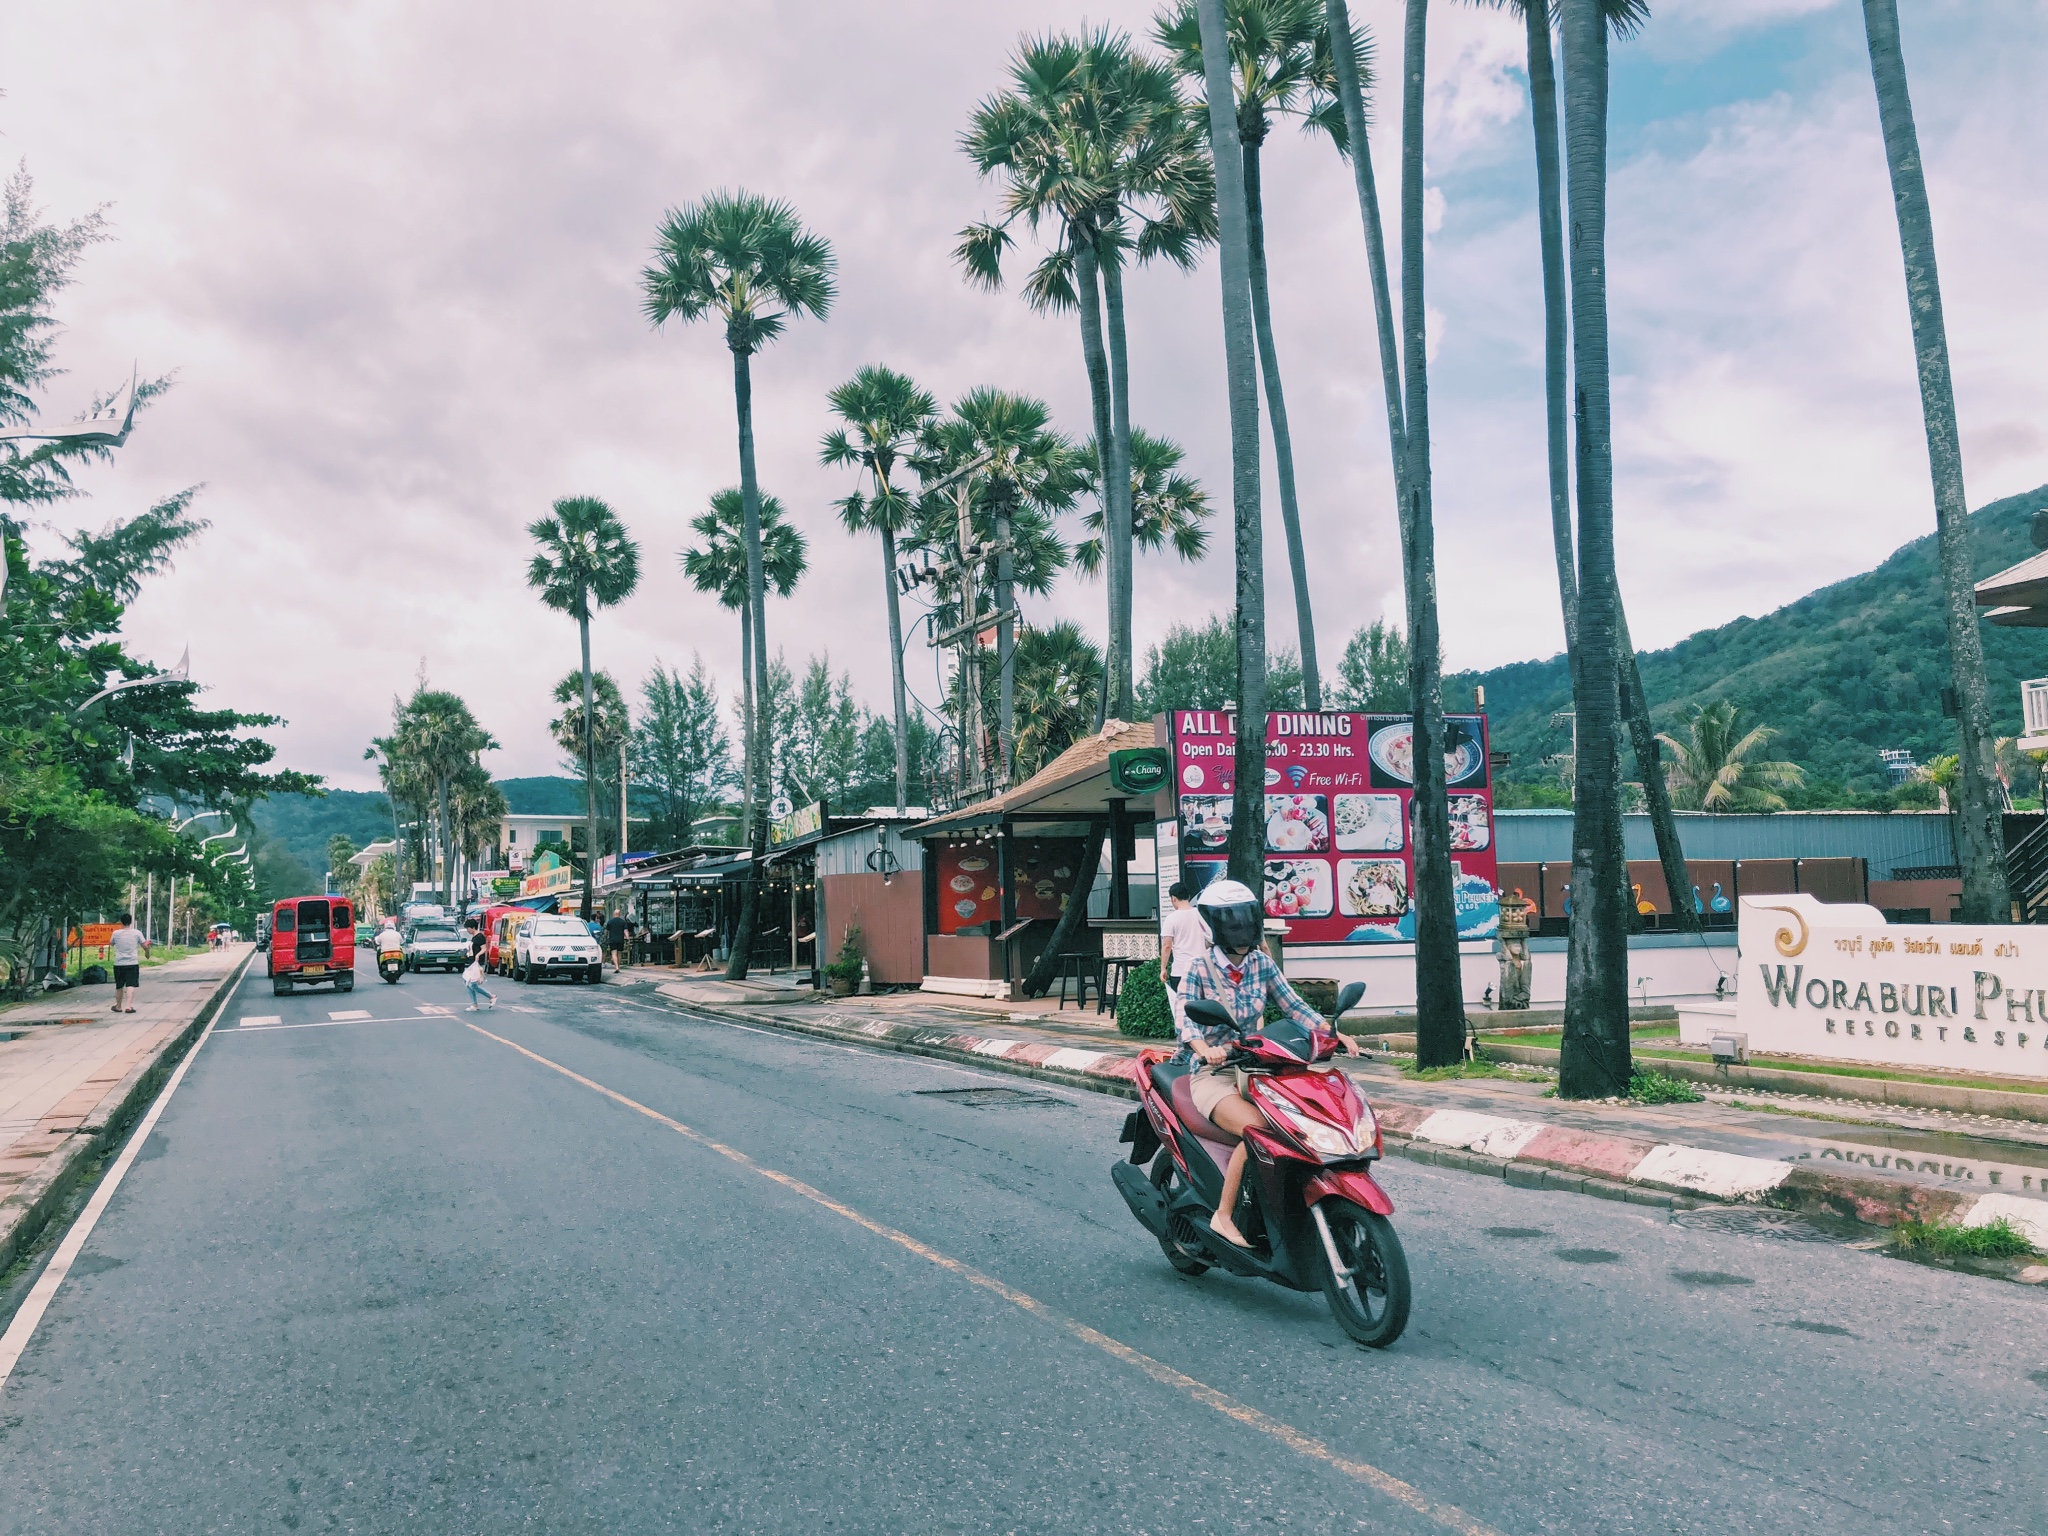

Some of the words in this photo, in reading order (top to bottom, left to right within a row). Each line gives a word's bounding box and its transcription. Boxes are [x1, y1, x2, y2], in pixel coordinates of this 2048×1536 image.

[1181, 713, 1222, 735] ALL
[1277, 714, 1352, 736] DINING
[1182, 742, 1213, 759] Open
[1217, 742, 1236, 756] Dai
[1300, 743, 1330, 757] 23.30
[1333, 743, 1355, 757] Hrs.
[1136, 765, 1162, 775] Chang
[1309, 773, 1331, 786] Free
[1335, 772, 1362, 786] Wi-Fi
[1994, 940, 2019, 957] สปา
[1759, 964, 1958, 1017] WORABURI
[1825, 1018, 1948, 1041] RESORT
[1963, 1026, 1978, 1042] &
